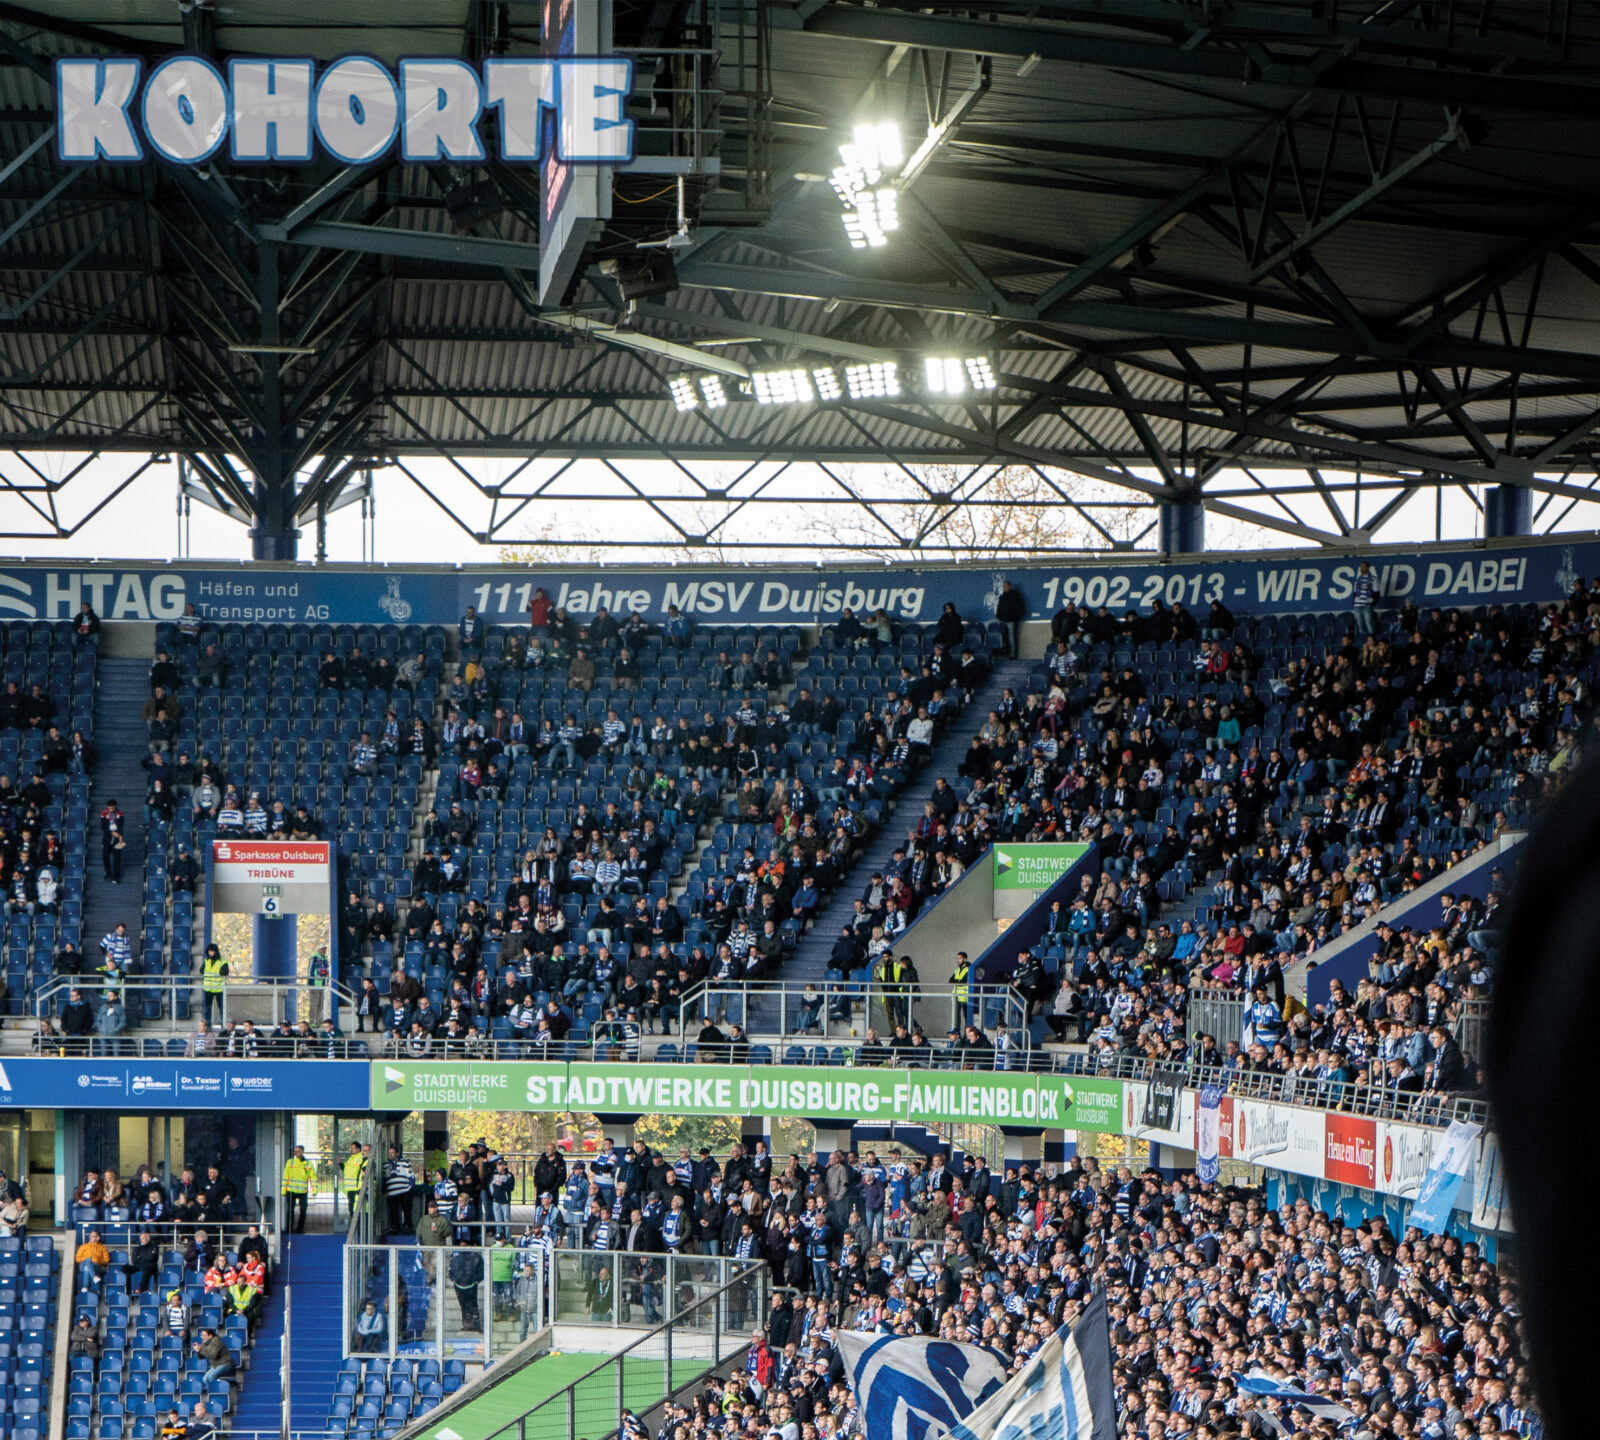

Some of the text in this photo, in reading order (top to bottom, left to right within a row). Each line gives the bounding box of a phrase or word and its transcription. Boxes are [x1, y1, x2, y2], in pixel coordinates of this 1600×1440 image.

[200, 581, 299, 597] Häfen und
[1256, 568, 1323, 603] WIR
[1424, 557, 1528, 597] DABEI
[46, 573, 187, 619] HTAG
[473, 582, 533, 613] 111
[660, 582, 754, 613] MSV
[759, 582, 925, 616] Duisburg
[200, 603, 330, 622] Transport AG
[234, 851, 325, 862] Sparkasse Duisburg
[248, 868, 295, 878] TRIBÜNE
[264, 897, 277, 911] 6
[414, 1075, 508, 1088] STADTWERKE
[414, 1090, 487, 1103] DUISBURG
[526, 1076, 1059, 1121] STADTWERKE DUISBURG-FAMILIENBLOCK
[1076, 1090, 1119, 1110] STADTWERKE
[1076, 1108, 1110, 1125] DUISBURG
[1327, 1132, 1346, 1161] Heute
[1355, 1137, 1375, 1181] König
